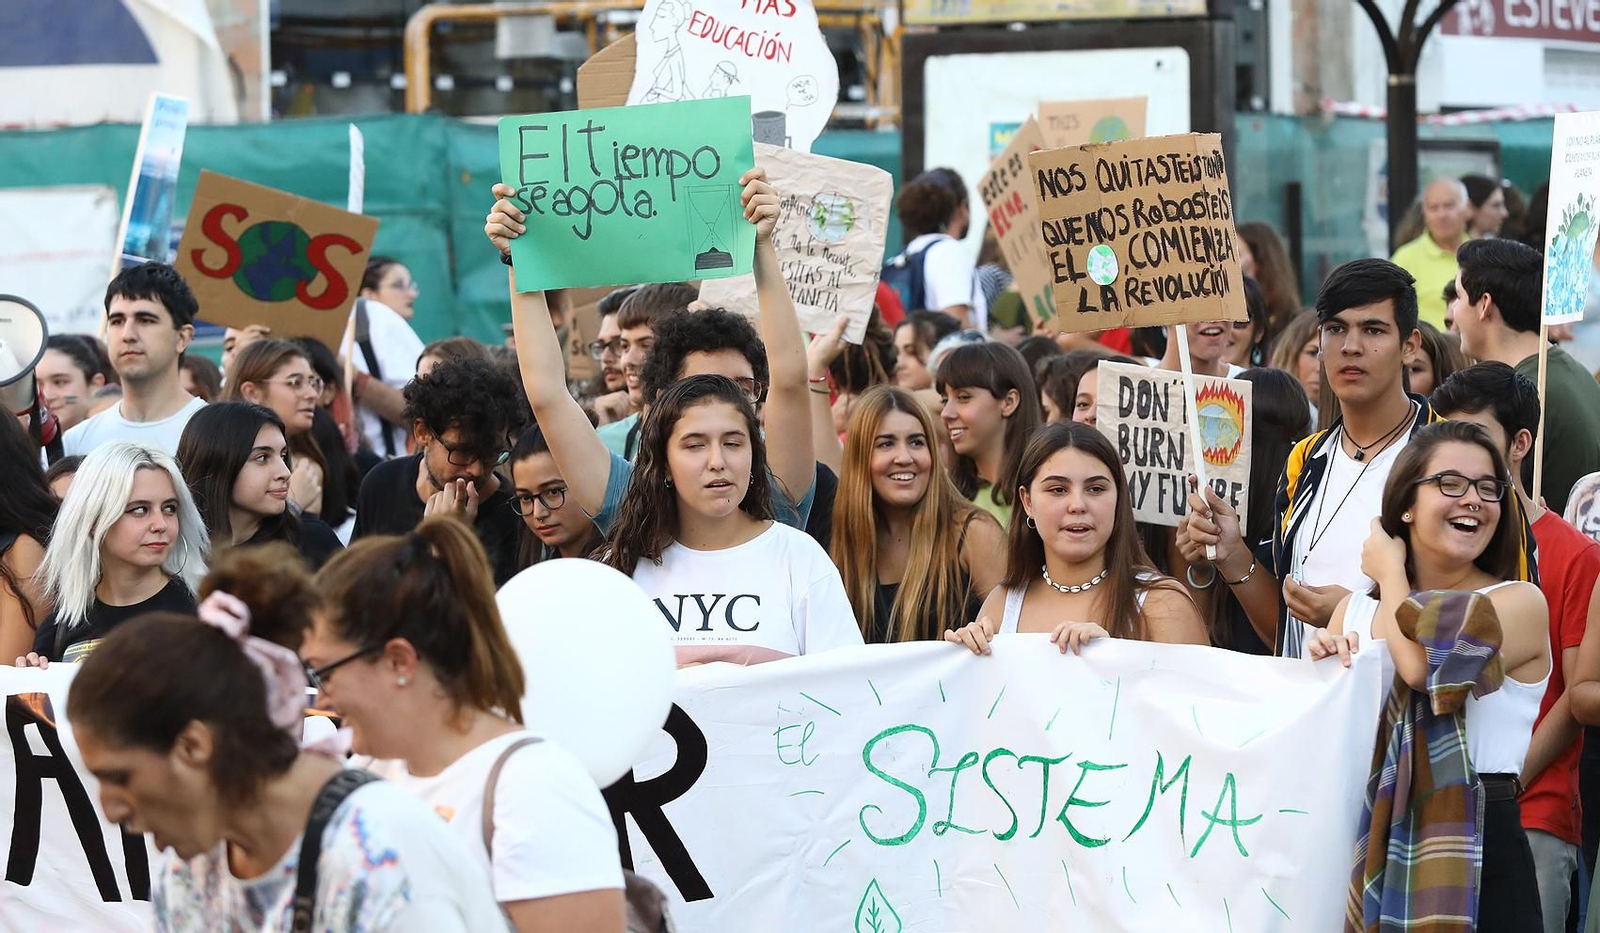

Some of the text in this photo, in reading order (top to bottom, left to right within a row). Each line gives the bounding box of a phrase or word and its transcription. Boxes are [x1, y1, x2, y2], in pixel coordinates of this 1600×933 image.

[687, 10, 793, 63] EDUCACIÓN
[518, 119, 721, 202] El Tiempo
[1037, 163, 1087, 201] NOS
[781, 259, 823, 285] ESITAS
[1050, 225, 1236, 284] EL COMIENZA
[1077, 285, 1122, 313] LA
[1118, 422, 1185, 471] BURN
[1158, 472, 1243, 522] FURE
[652, 593, 761, 633] NYC
[773, 721, 820, 766] El
[858, 723, 1264, 858] SISTEMA
